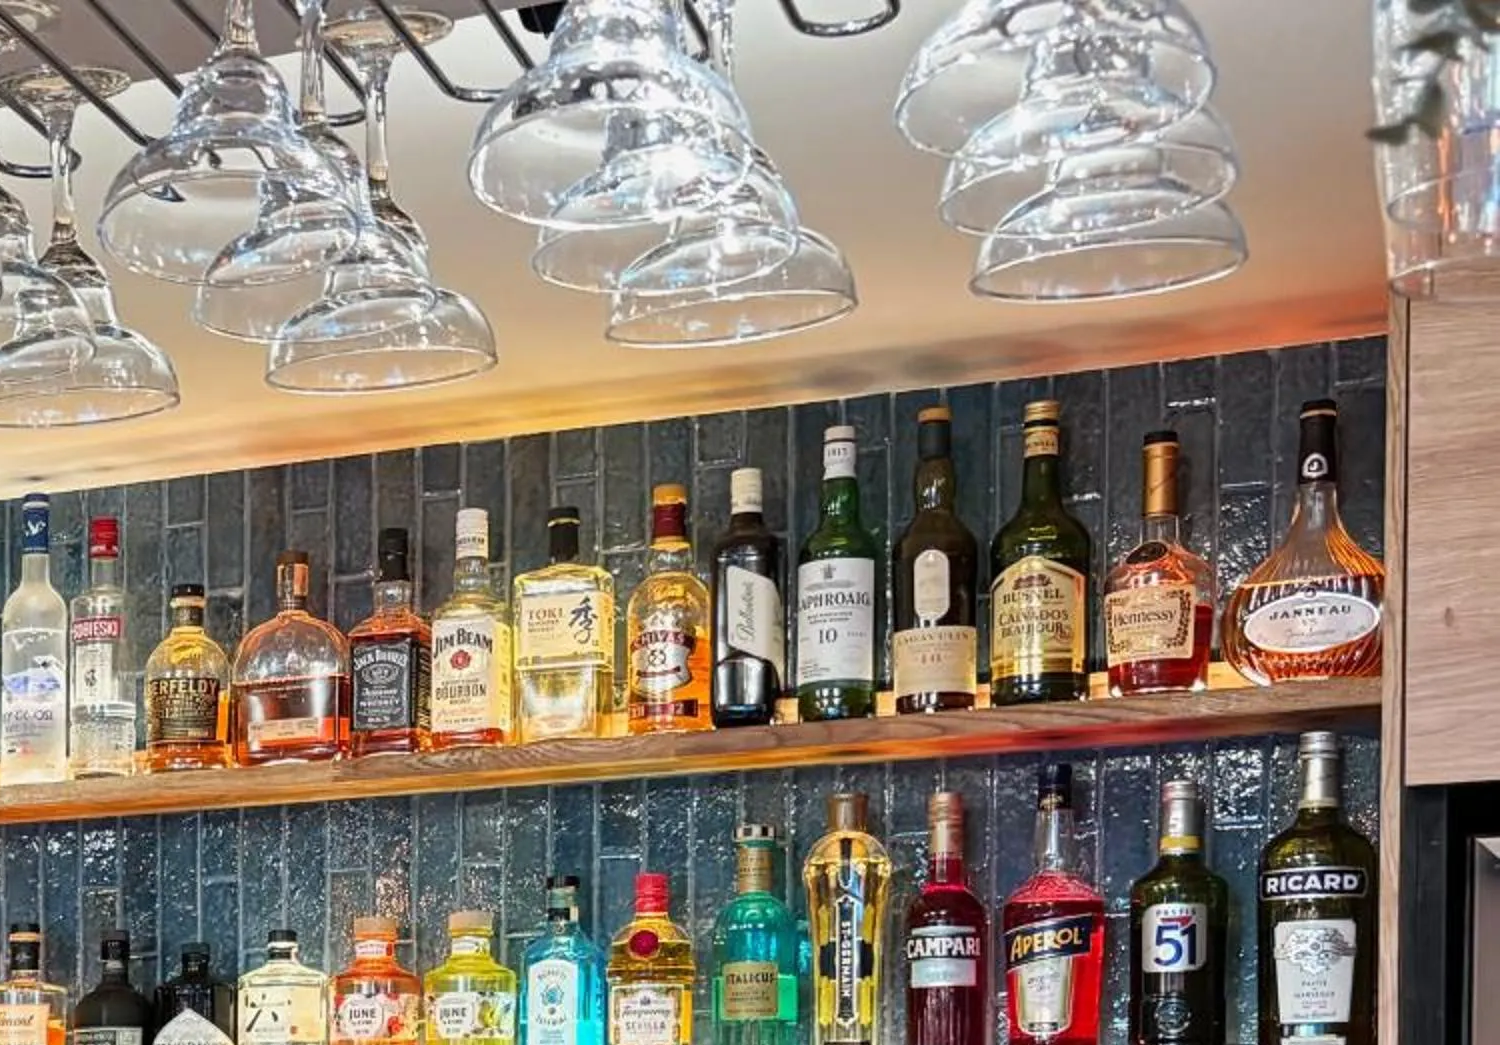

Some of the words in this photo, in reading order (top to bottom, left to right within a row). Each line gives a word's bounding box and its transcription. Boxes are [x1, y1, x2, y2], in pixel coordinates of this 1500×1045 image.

[527, 607, 564, 620] TOKI
[1113, 609, 1176, 629] Hennessy
[1269, 605, 1351, 620] JANNEAU
[434, 631, 456, 659] JIM
[456, 628, 493, 654] BEAM
[818, 628, 838, 645] 10
[149, 678, 218, 695] ERFELDY
[435, 685, 487, 701] BOURBON
[1266, 873, 1359, 894] RICARD
[1155, 908, 1198, 917] PASTIS
[907, 936, 981, 959] CAMPARI
[1010, 927, 1084, 963] APEROL
[1153, 923, 1197, 967] 51
[840, 920, 852, 998] ST-GERMAIN
[349, 1007, 377, 1021] JUNE
[440, 1007, 467, 1021] JUNE
